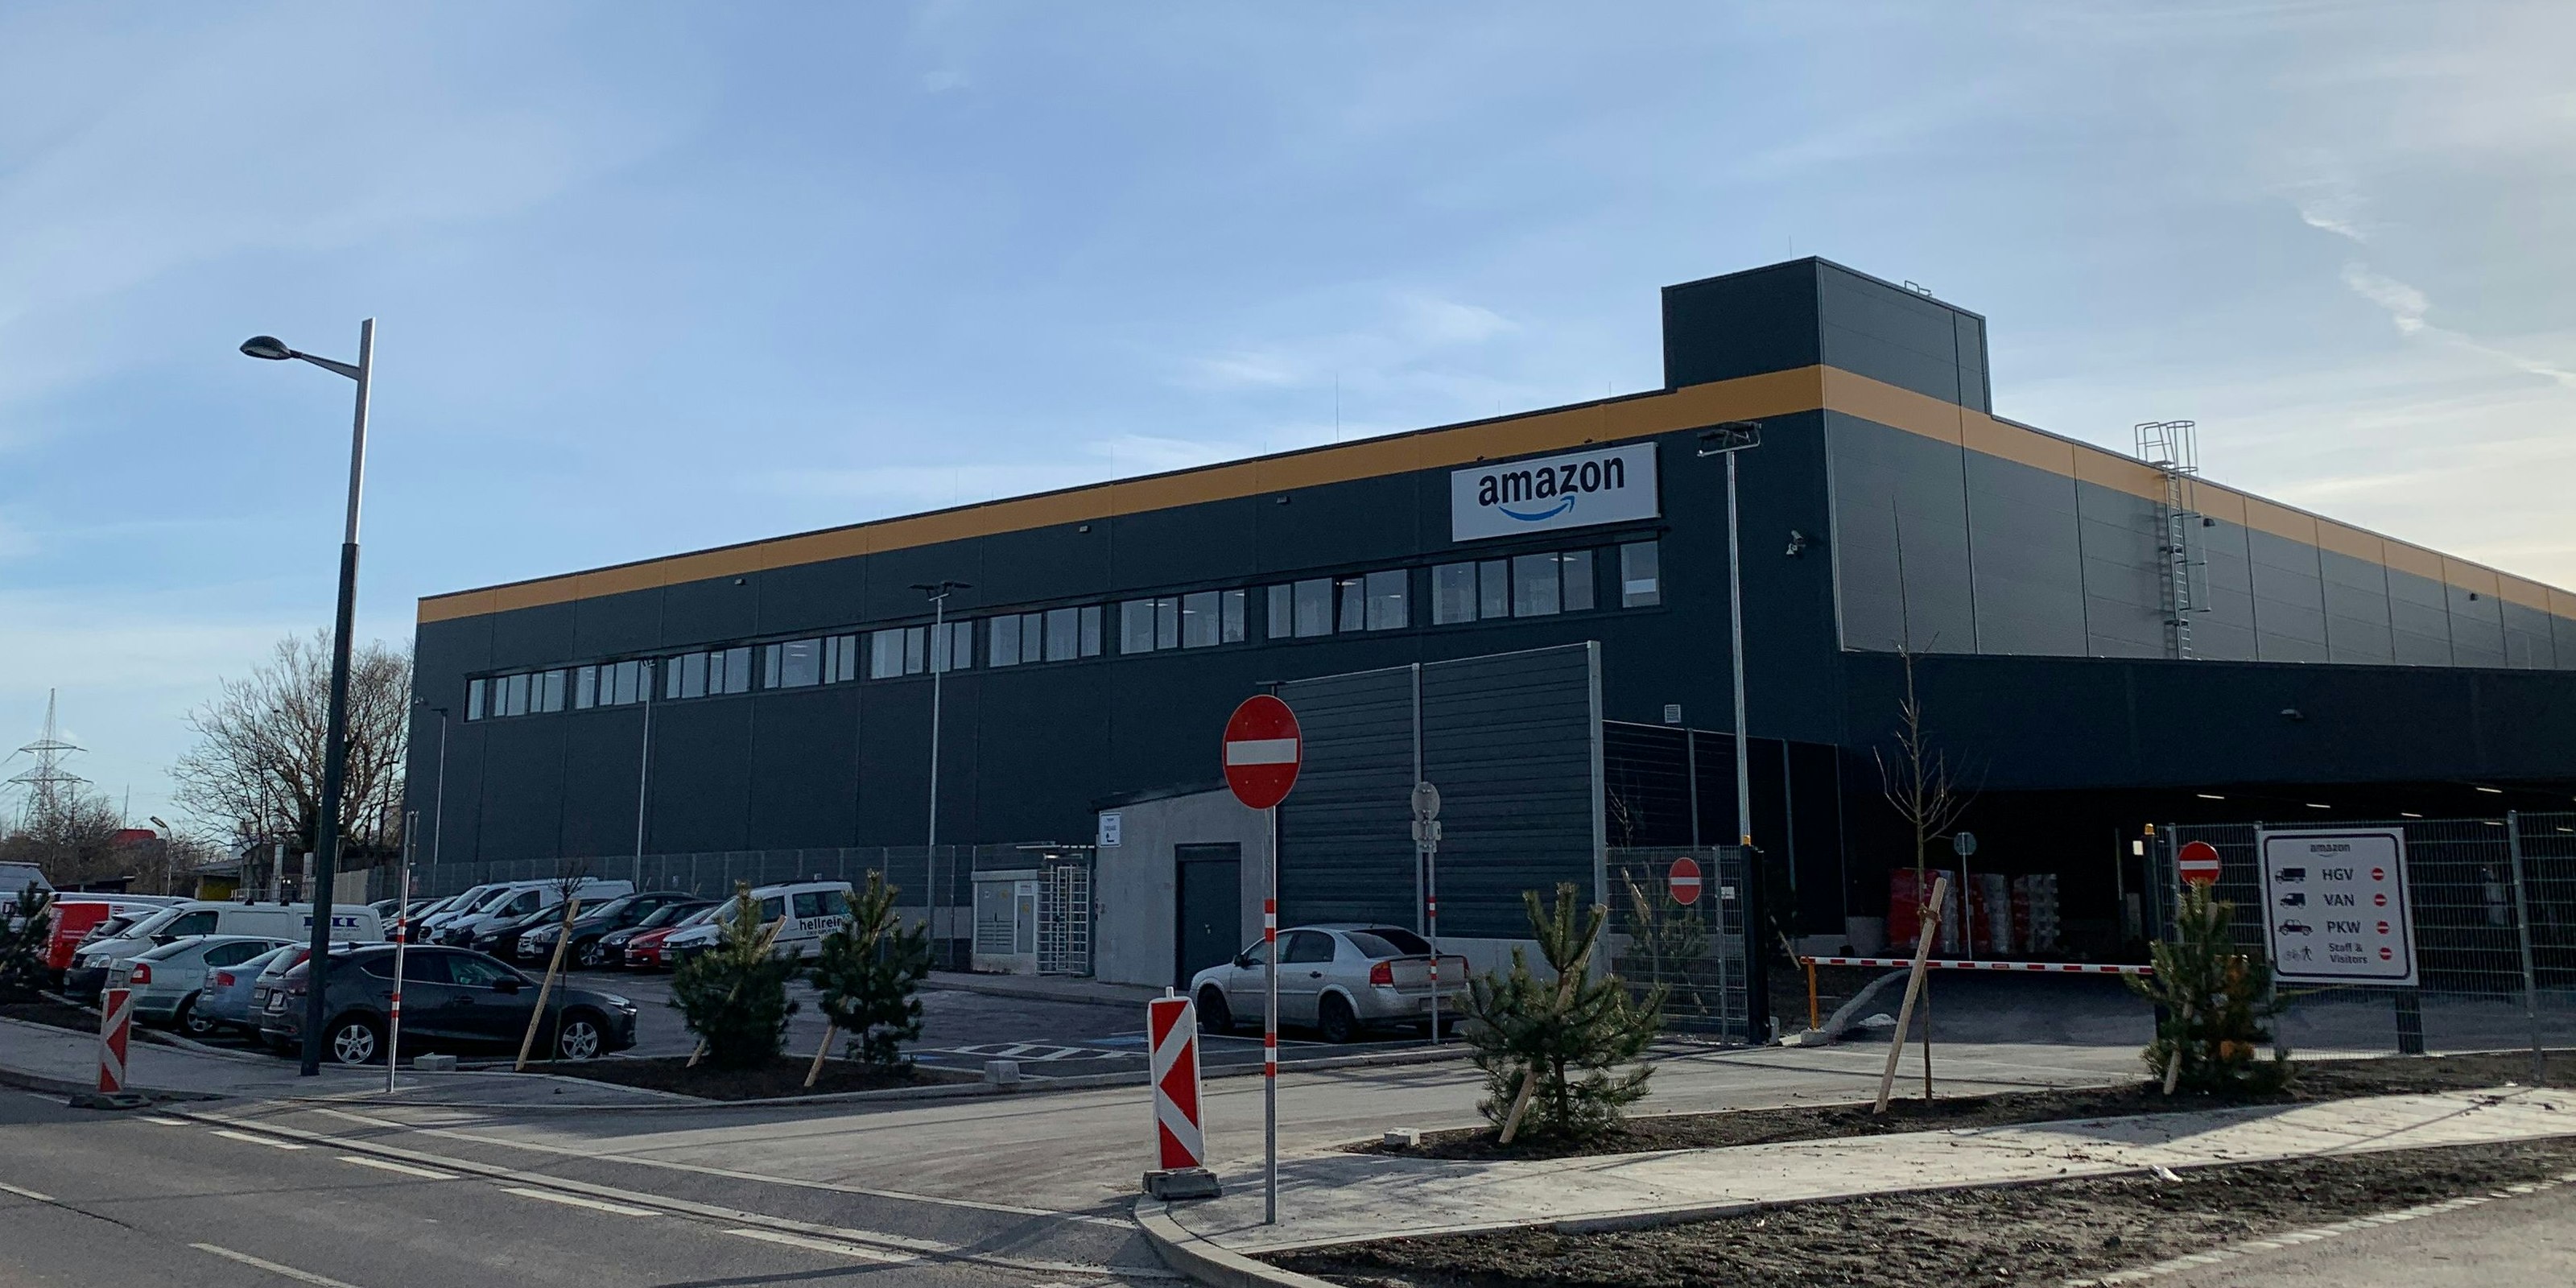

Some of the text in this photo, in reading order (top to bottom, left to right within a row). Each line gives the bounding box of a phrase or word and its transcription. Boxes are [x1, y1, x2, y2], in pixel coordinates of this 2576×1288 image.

[1479, 457, 1624, 506] amazon
[2310, 844, 2351, 852] amazon
[2322, 868, 2353, 881] HGV
[2323, 894, 2355, 906] VAN
[2326, 920, 2360, 933] PKW
[2329, 942, 2363, 952] Staff &
[2330, 954, 2368, 964] Visitors
